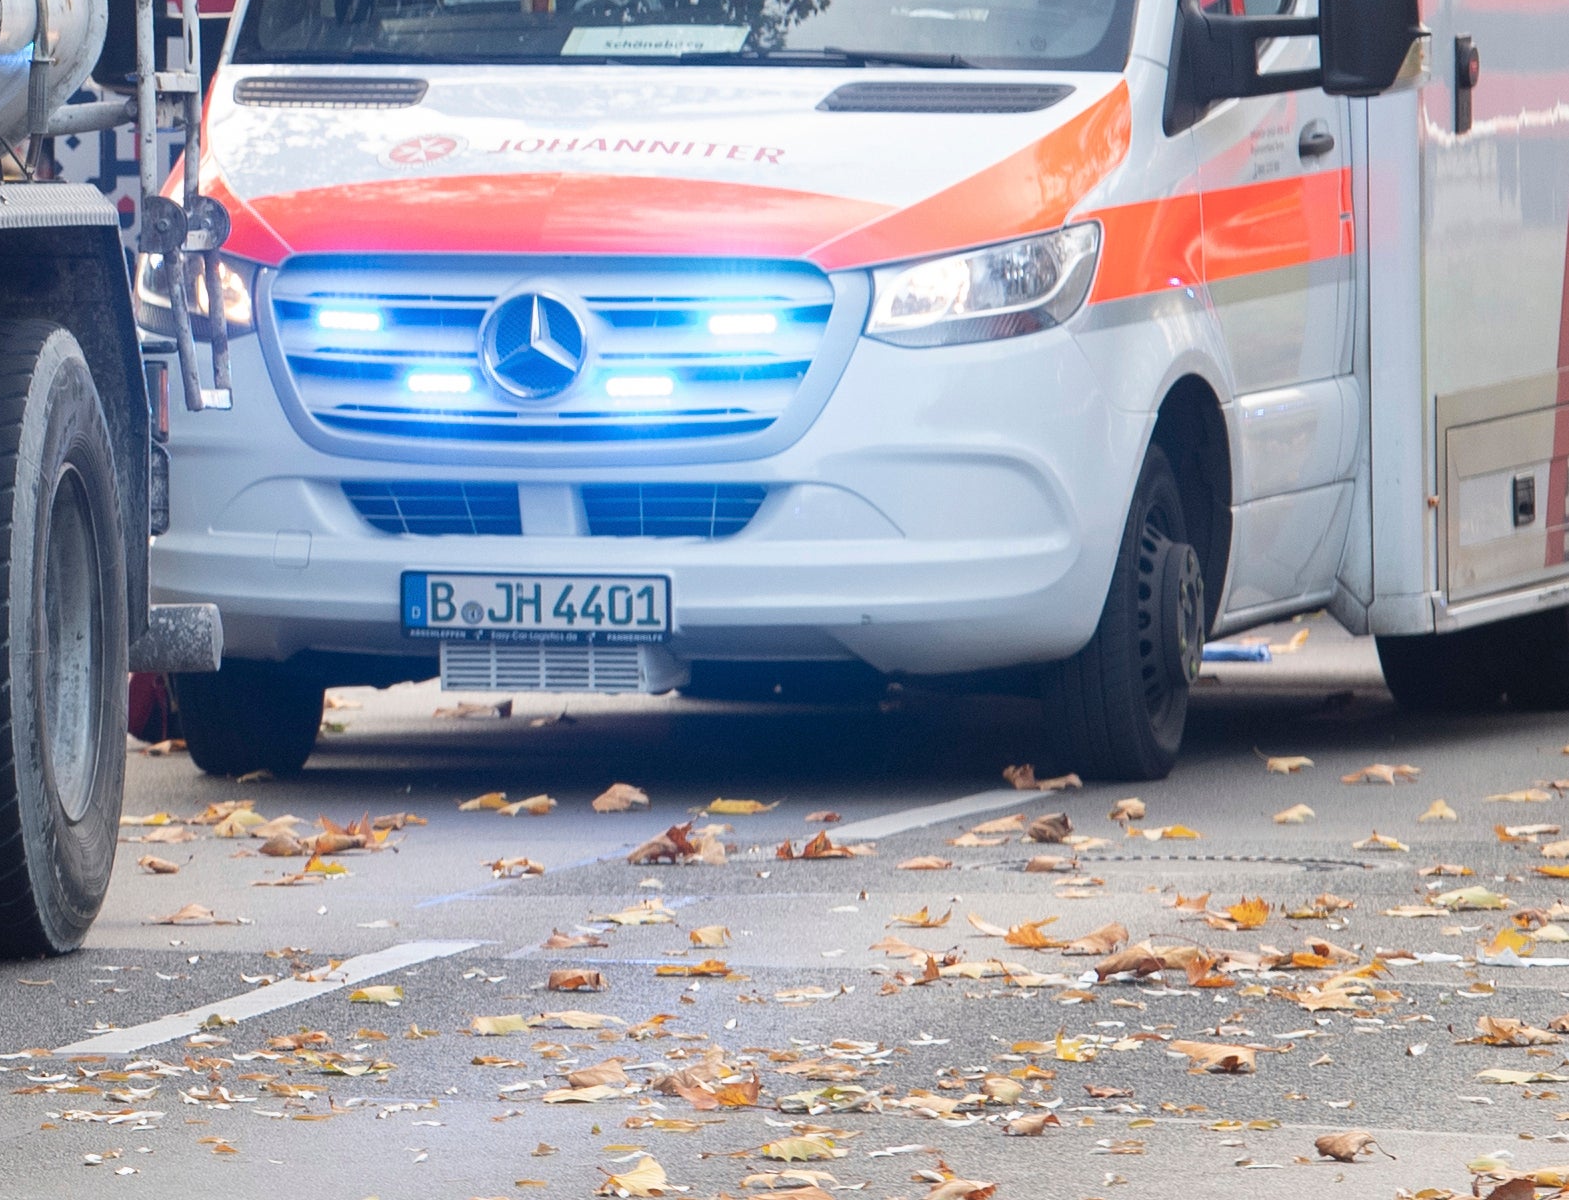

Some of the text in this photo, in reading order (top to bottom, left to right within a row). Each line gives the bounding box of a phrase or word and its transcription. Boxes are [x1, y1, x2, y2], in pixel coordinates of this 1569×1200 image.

[486, 137, 786, 166] JOHANNITER
[411, 605, 422, 620] D
[430, 581, 661, 626] B JH 4401
